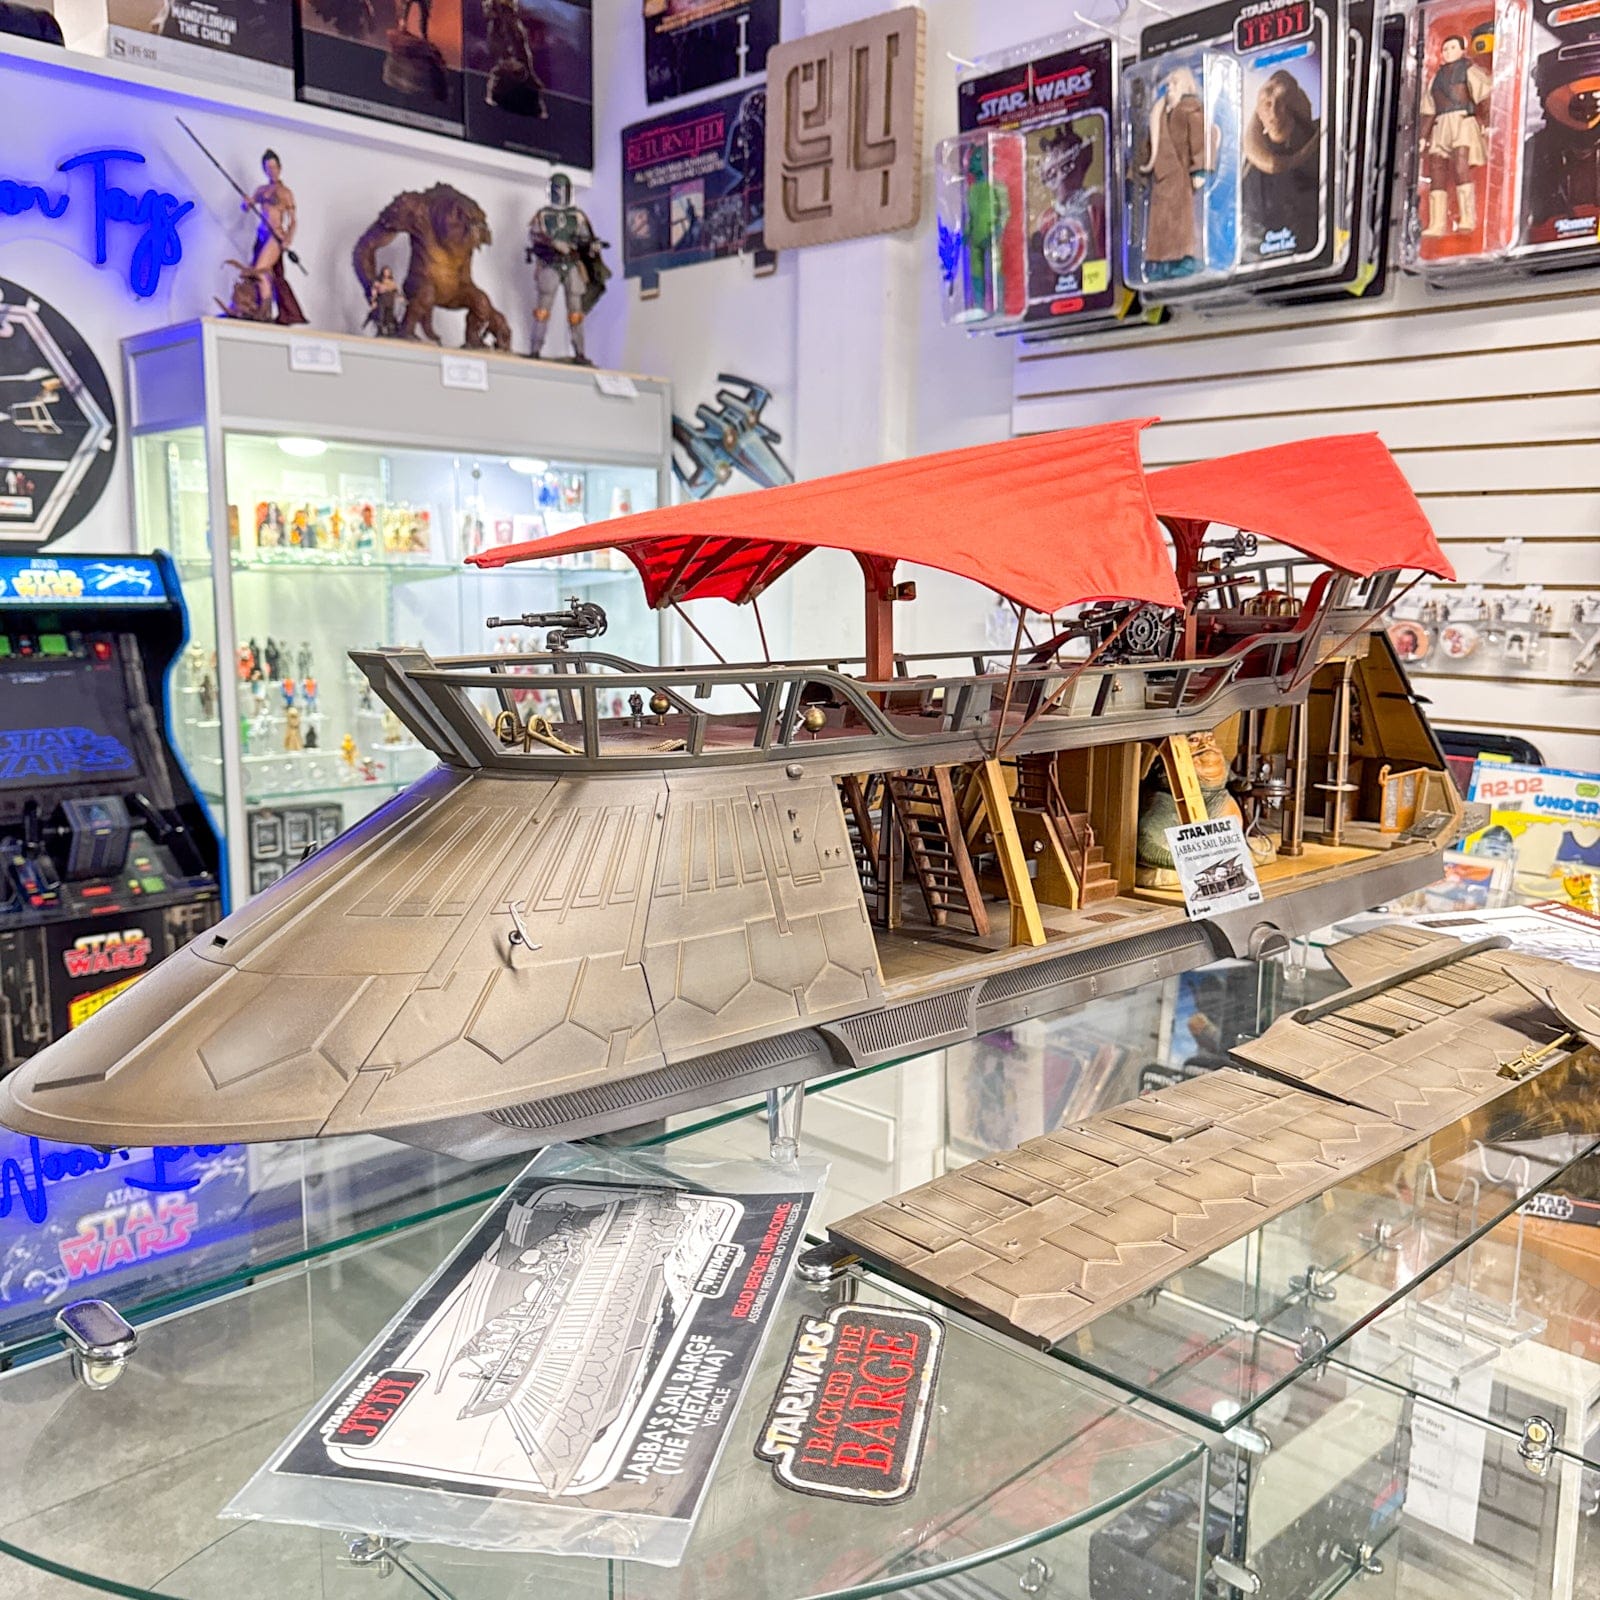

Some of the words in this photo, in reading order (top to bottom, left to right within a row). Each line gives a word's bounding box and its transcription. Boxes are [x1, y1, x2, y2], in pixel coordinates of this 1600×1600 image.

[179, 19, 200, 38] THE
[200, 26, 232, 46] CHILD
[1242, 6, 1305, 48] JEDI
[976, 91, 1027, 121] STAR
[1034, 70, 1093, 104] WARS
[627, 133, 683, 165] RETURN
[688, 118, 725, 158] JEDI
[1554, 216, 1596, 233] Kenner
[1481, 777, 1544, 798] R2-D2
[1177, 826, 1206, 842] STAR
[1203, 820, 1231, 836] WARS
[64, 928, 152, 959] STAR
[65, 944, 152, 978] WARS
[60, 1192, 198, 1251] STAR
[1531, 1195, 1568, 1208] TAR
[60, 1216, 198, 1280] WARS
[759, 1202, 793, 1254] UNPACKING.
[780, 1225, 794, 1247] TOOLS
[696, 1245, 731, 1290] VINTAGE
[743, 1254, 772, 1290] BEFORE
[776, 1244, 787, 1260] NO
[731, 1291, 756, 1318] READ
[747, 1290, 770, 1324] ASSEMBLY
[671, 1334, 712, 1382] BARGE
[782, 1319, 836, 1393] WARS
[834, 1324, 866, 1366] THE
[319, 1404, 356, 1434] STAR
[341, 1374, 380, 1405] WARS
[351, 1380, 417, 1437] JEDI
[652, 1437, 690, 1475] (THE
[671, 1348, 735, 1435] KHETANNA)
[655, 1384, 690, 1416] SAIL
[701, 1387, 731, 1428] VEHICLE
[805, 1370, 854, 1453] BACKED
[831, 1327, 920, 1476] BARGE
[762, 1389, 815, 1456] STAR
[622, 1415, 674, 1485] JABBA'S
[801, 1455, 828, 1466] I
